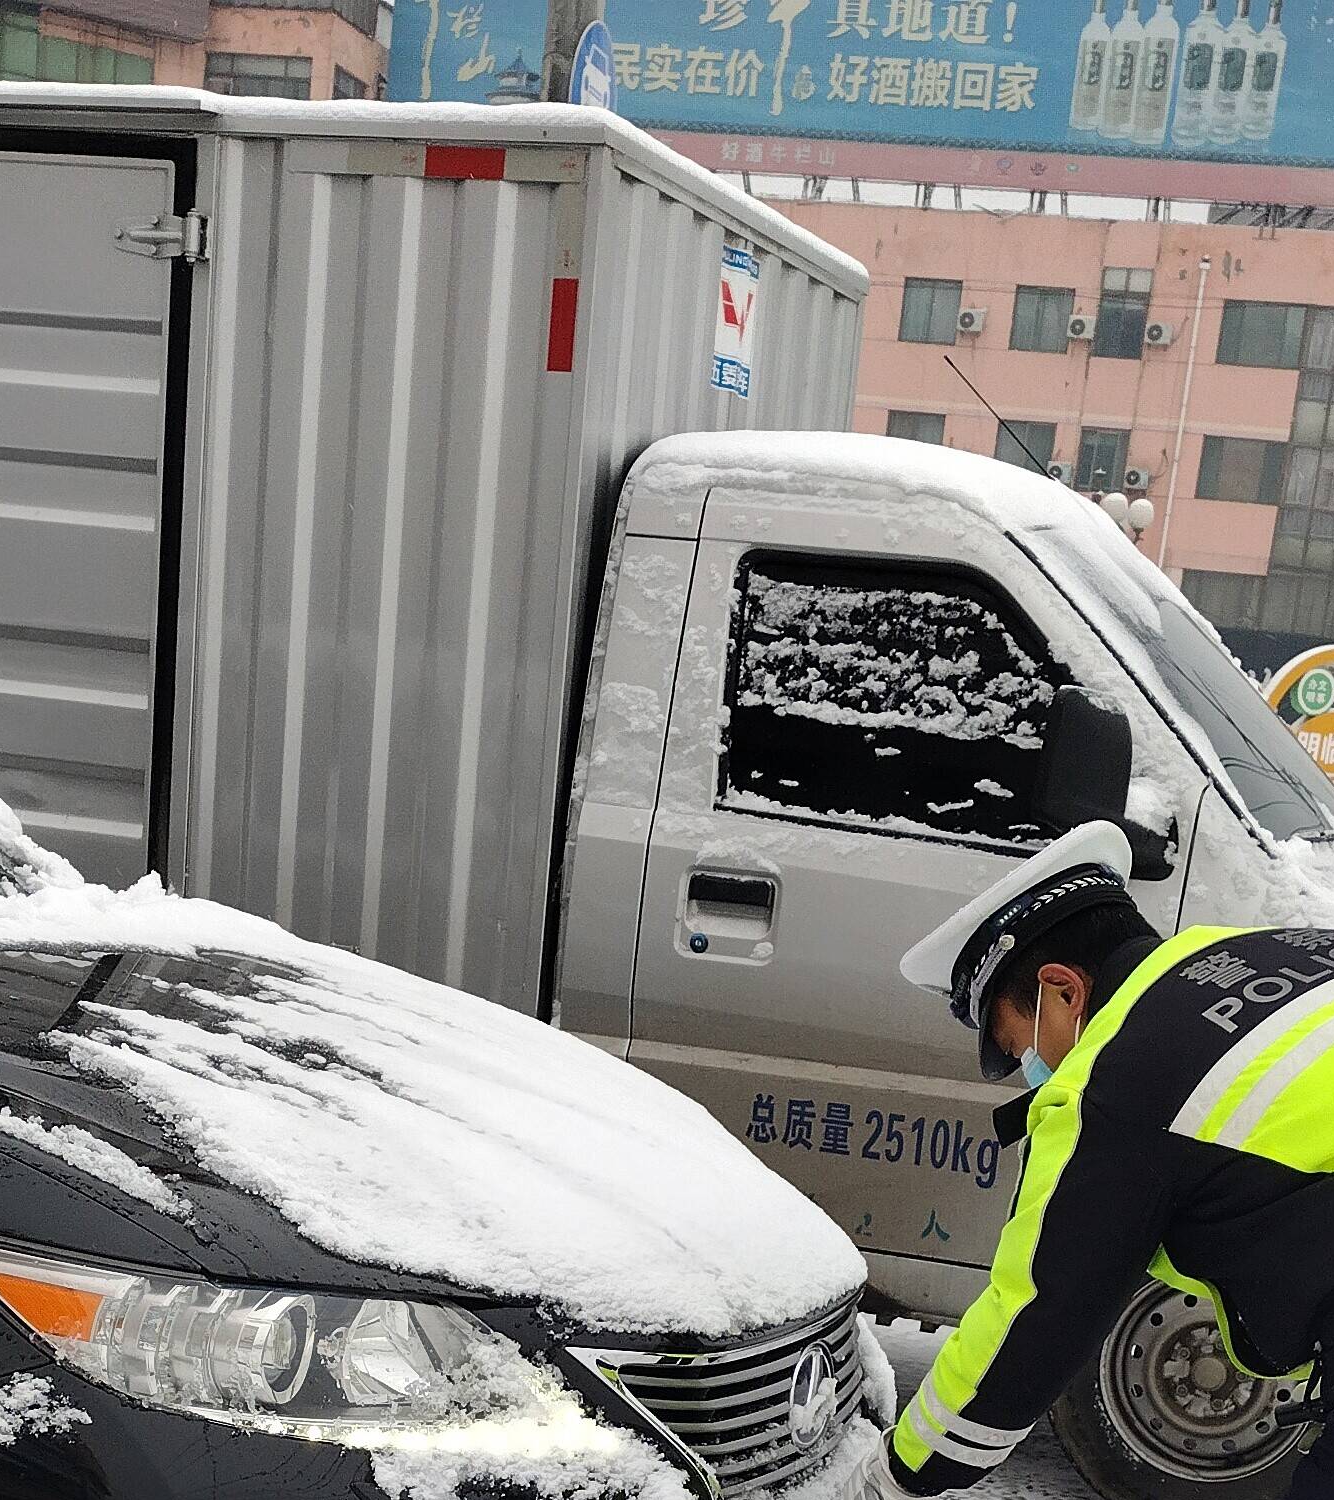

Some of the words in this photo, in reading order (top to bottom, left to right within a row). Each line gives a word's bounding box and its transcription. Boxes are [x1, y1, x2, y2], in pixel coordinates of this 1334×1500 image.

[826, 52, 1040, 112] 好酒搬回家
